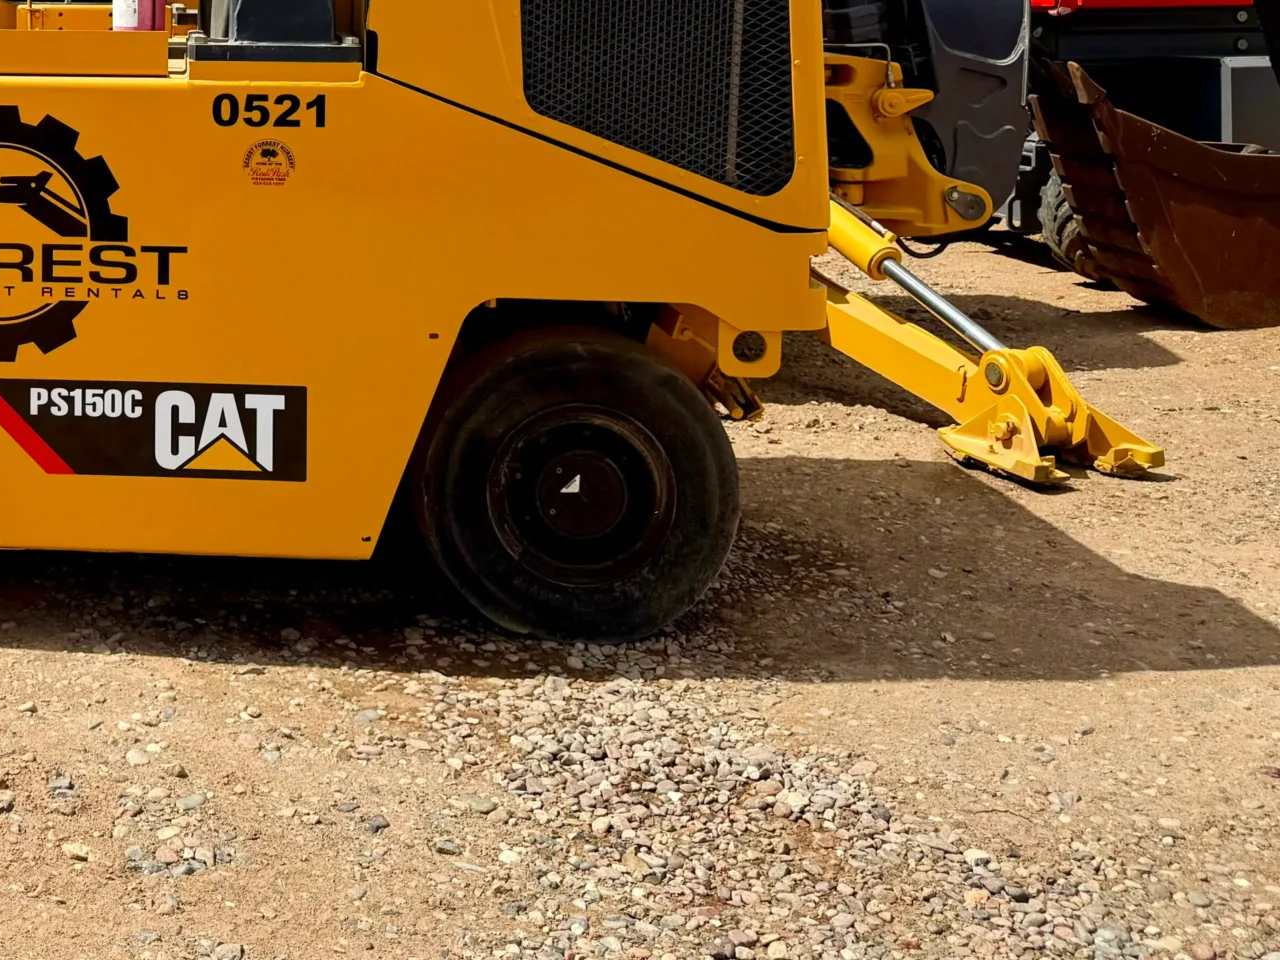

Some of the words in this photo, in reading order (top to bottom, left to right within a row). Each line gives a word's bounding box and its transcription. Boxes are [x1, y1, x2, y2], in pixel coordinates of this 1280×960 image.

[212, 93, 326, 128] 0521
[41, 286, 189, 300] RENTALS
[29, 387, 143, 418] PS150C
[155, 390, 285, 472] CAT
